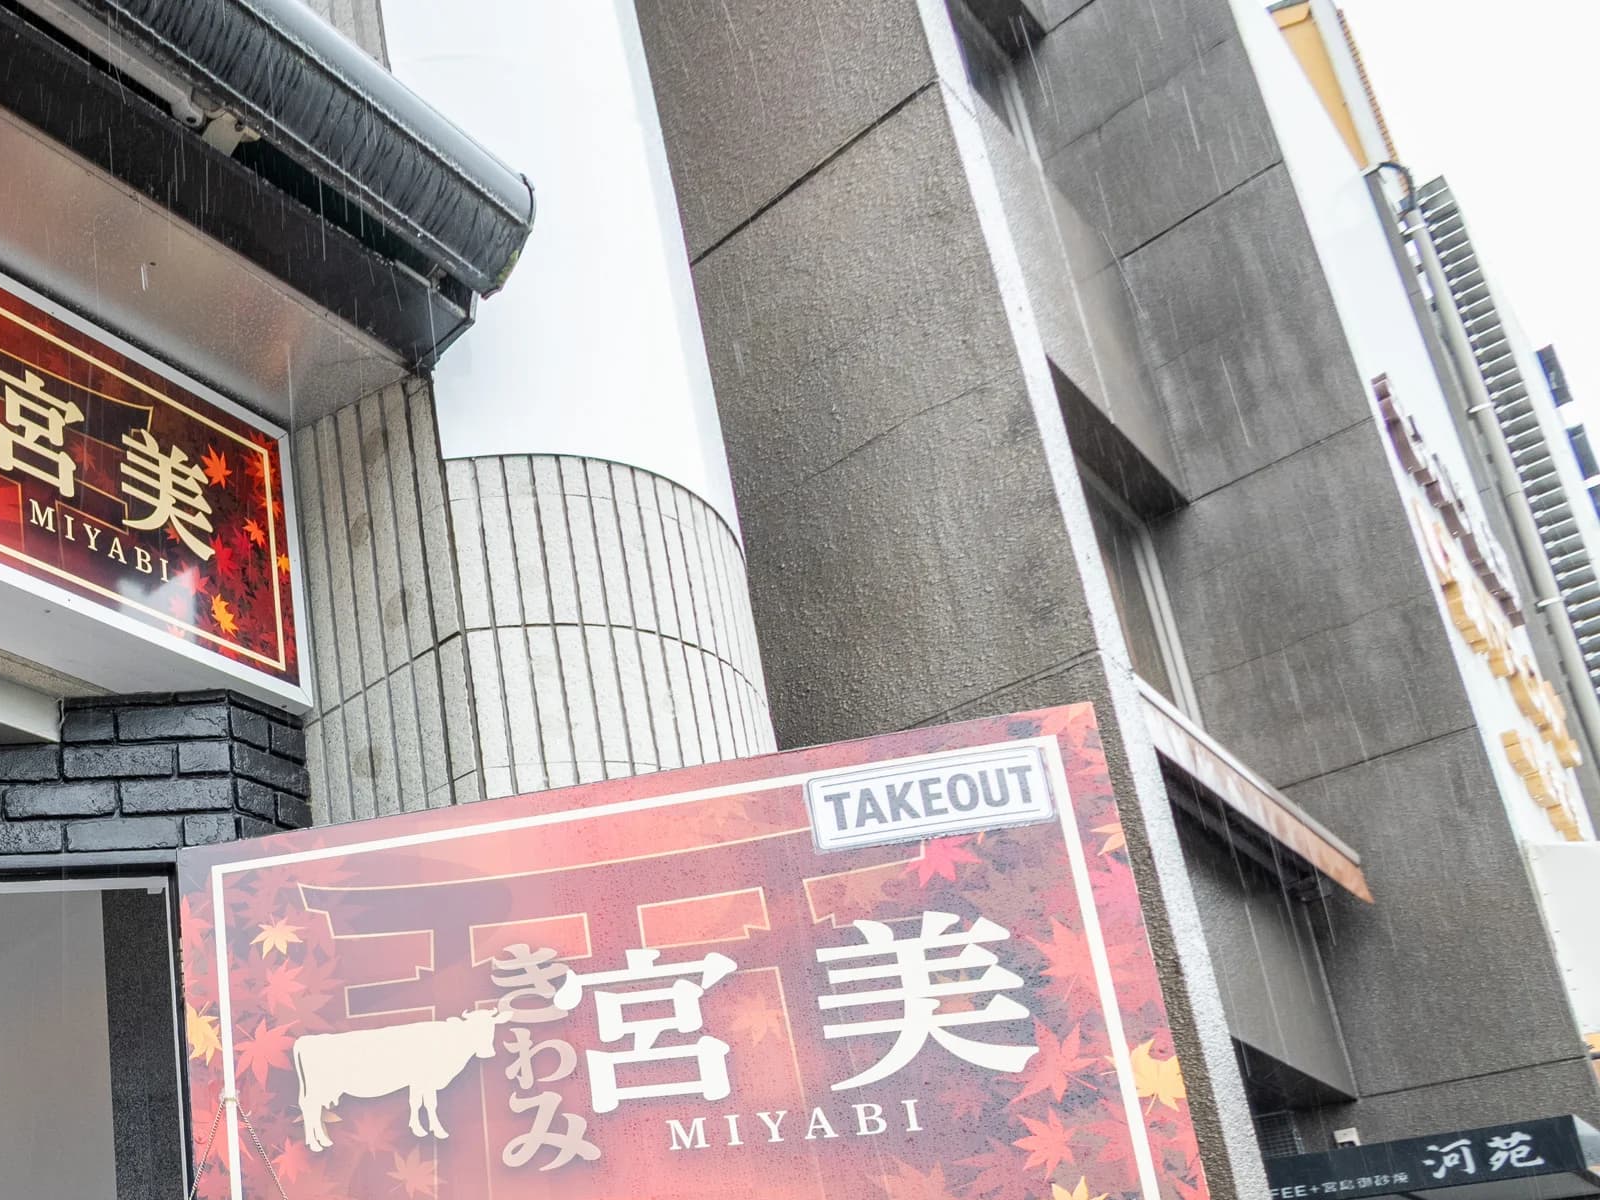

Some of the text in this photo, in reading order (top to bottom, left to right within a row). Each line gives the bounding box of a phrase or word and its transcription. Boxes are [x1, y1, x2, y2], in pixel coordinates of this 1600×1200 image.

[29, 498, 171, 583] MIYABI
[824, 764, 1034, 832] TAKEOUT
[554, 911, 1040, 1114] 宮美
[490, 943, 601, 1172] きわみ
[669, 1100, 925, 1152] MIYABI
[1421, 1131, 1545, 1179] 河苑
